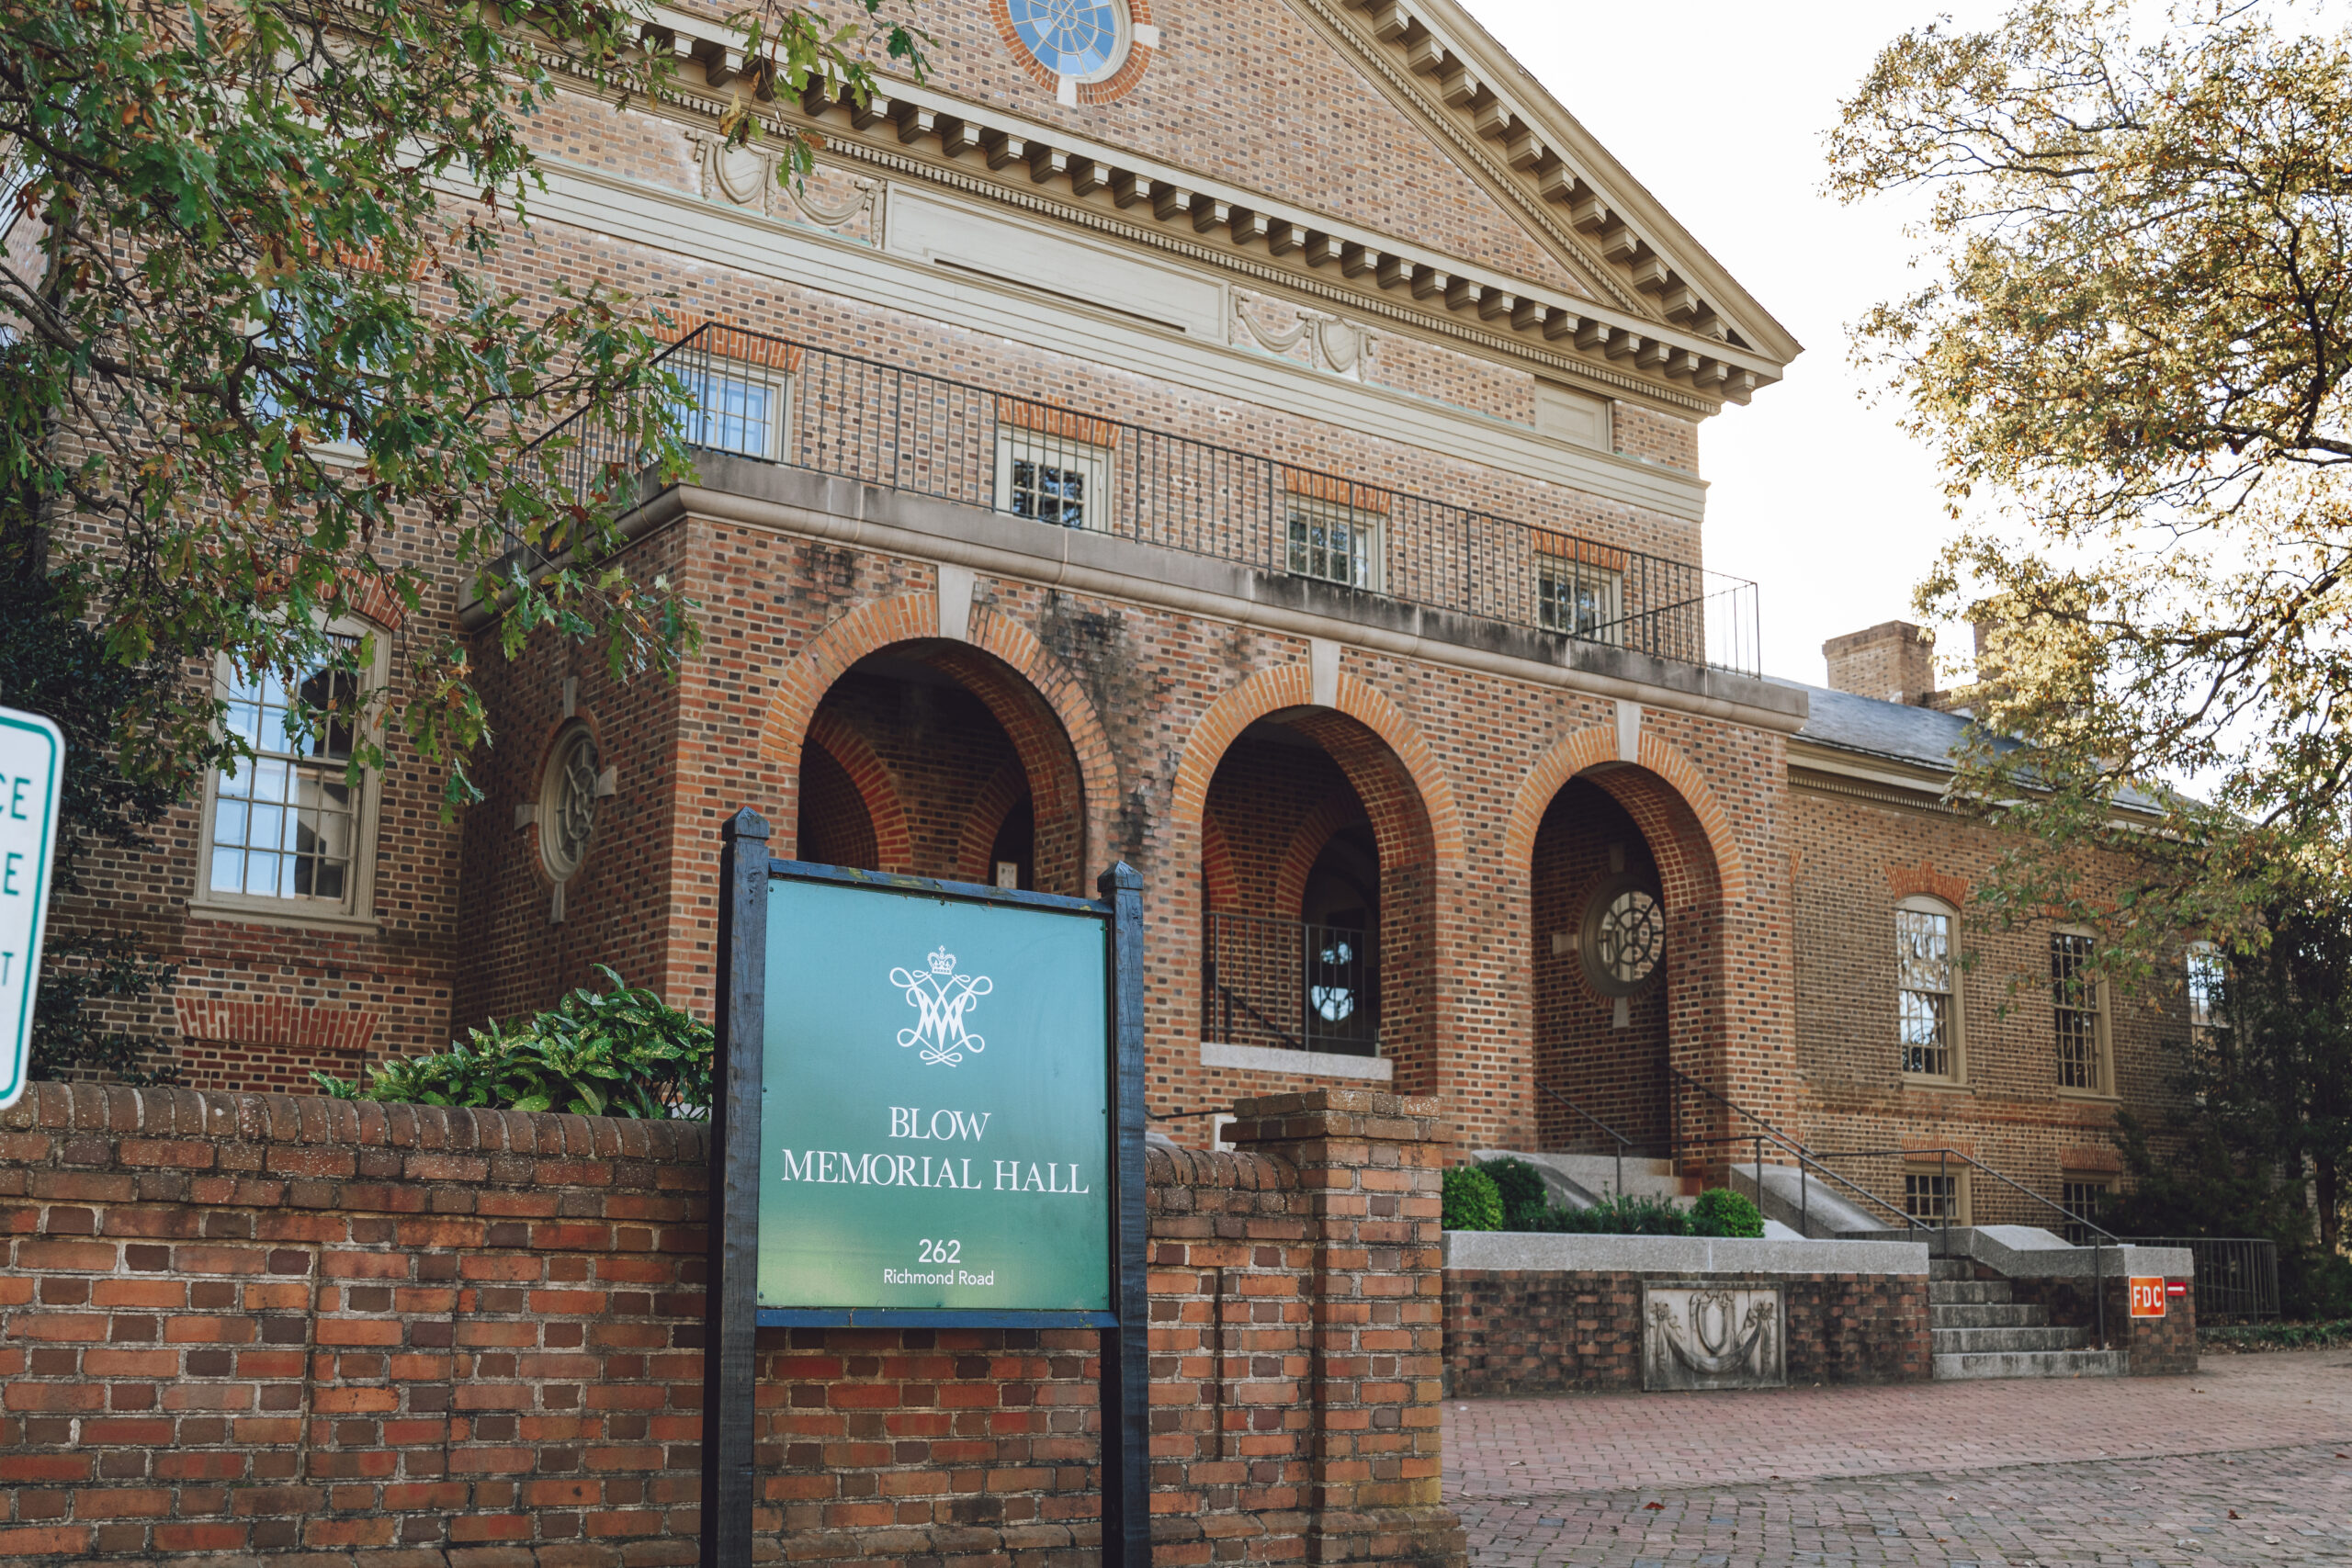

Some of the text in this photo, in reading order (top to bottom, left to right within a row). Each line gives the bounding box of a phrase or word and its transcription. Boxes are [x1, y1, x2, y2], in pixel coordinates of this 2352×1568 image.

[888, 1106, 992, 1142] BLOW
[781, 1148, 1090, 1194] MEMORIAL HALL
[918, 1238, 961, 1264] 262
[883, 1268, 995, 1286] Richmond Road
[2132, 1285, 2162, 1308] FDC
